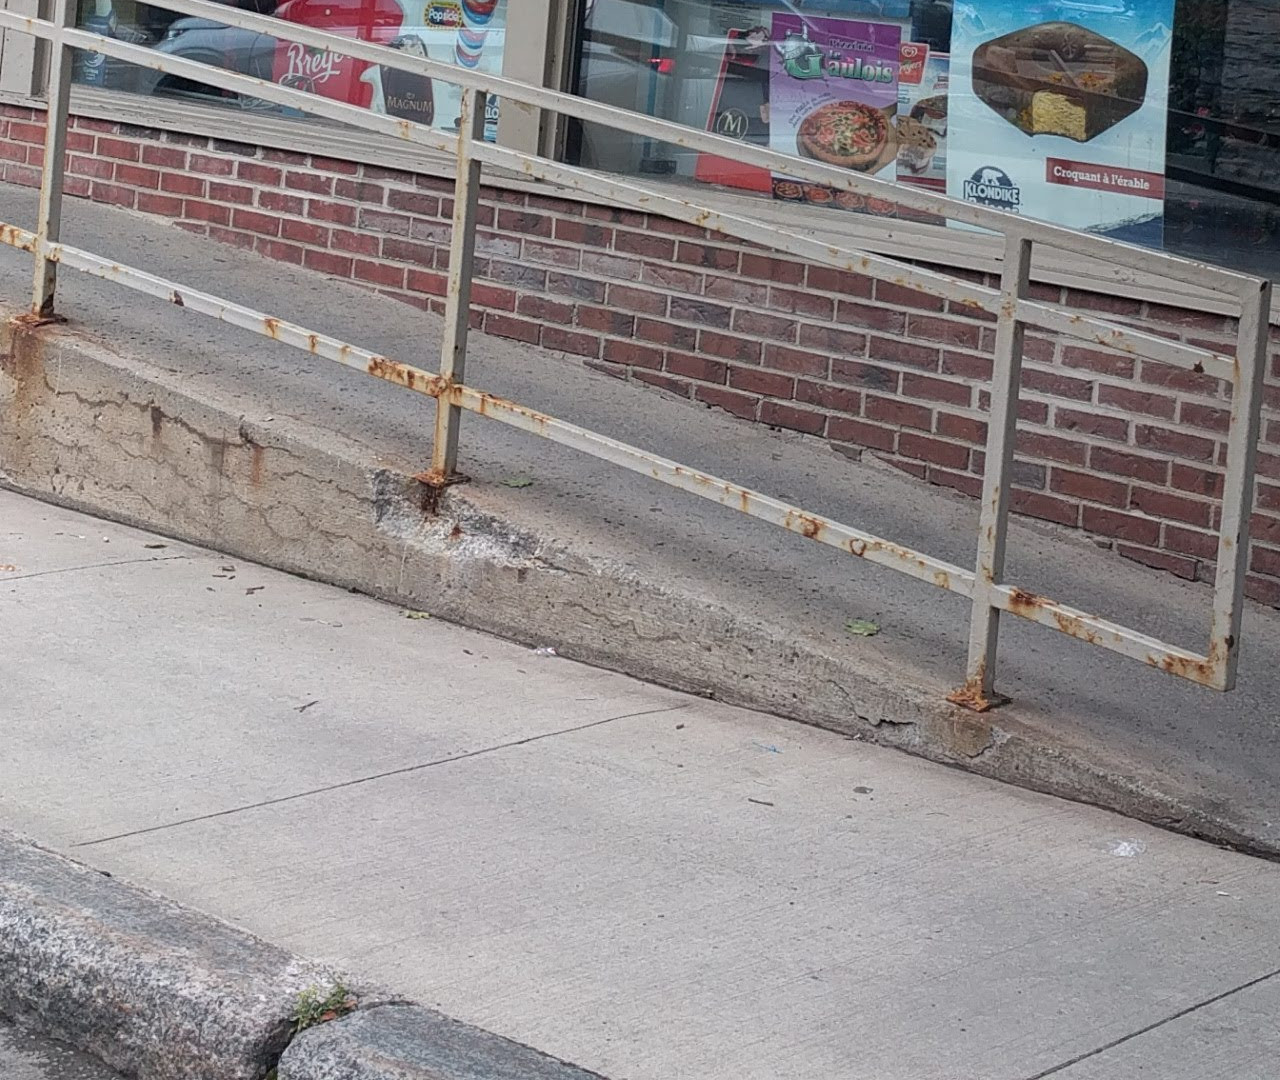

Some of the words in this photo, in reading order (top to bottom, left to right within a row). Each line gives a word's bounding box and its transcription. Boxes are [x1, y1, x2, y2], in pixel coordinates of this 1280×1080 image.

[387, 96, 433, 113] MAGNUM
[1053, 166, 1101, 184] Croquant
[1102, 173, 1109, 184] à
[964, 181, 1019, 204] KLONDIKE
